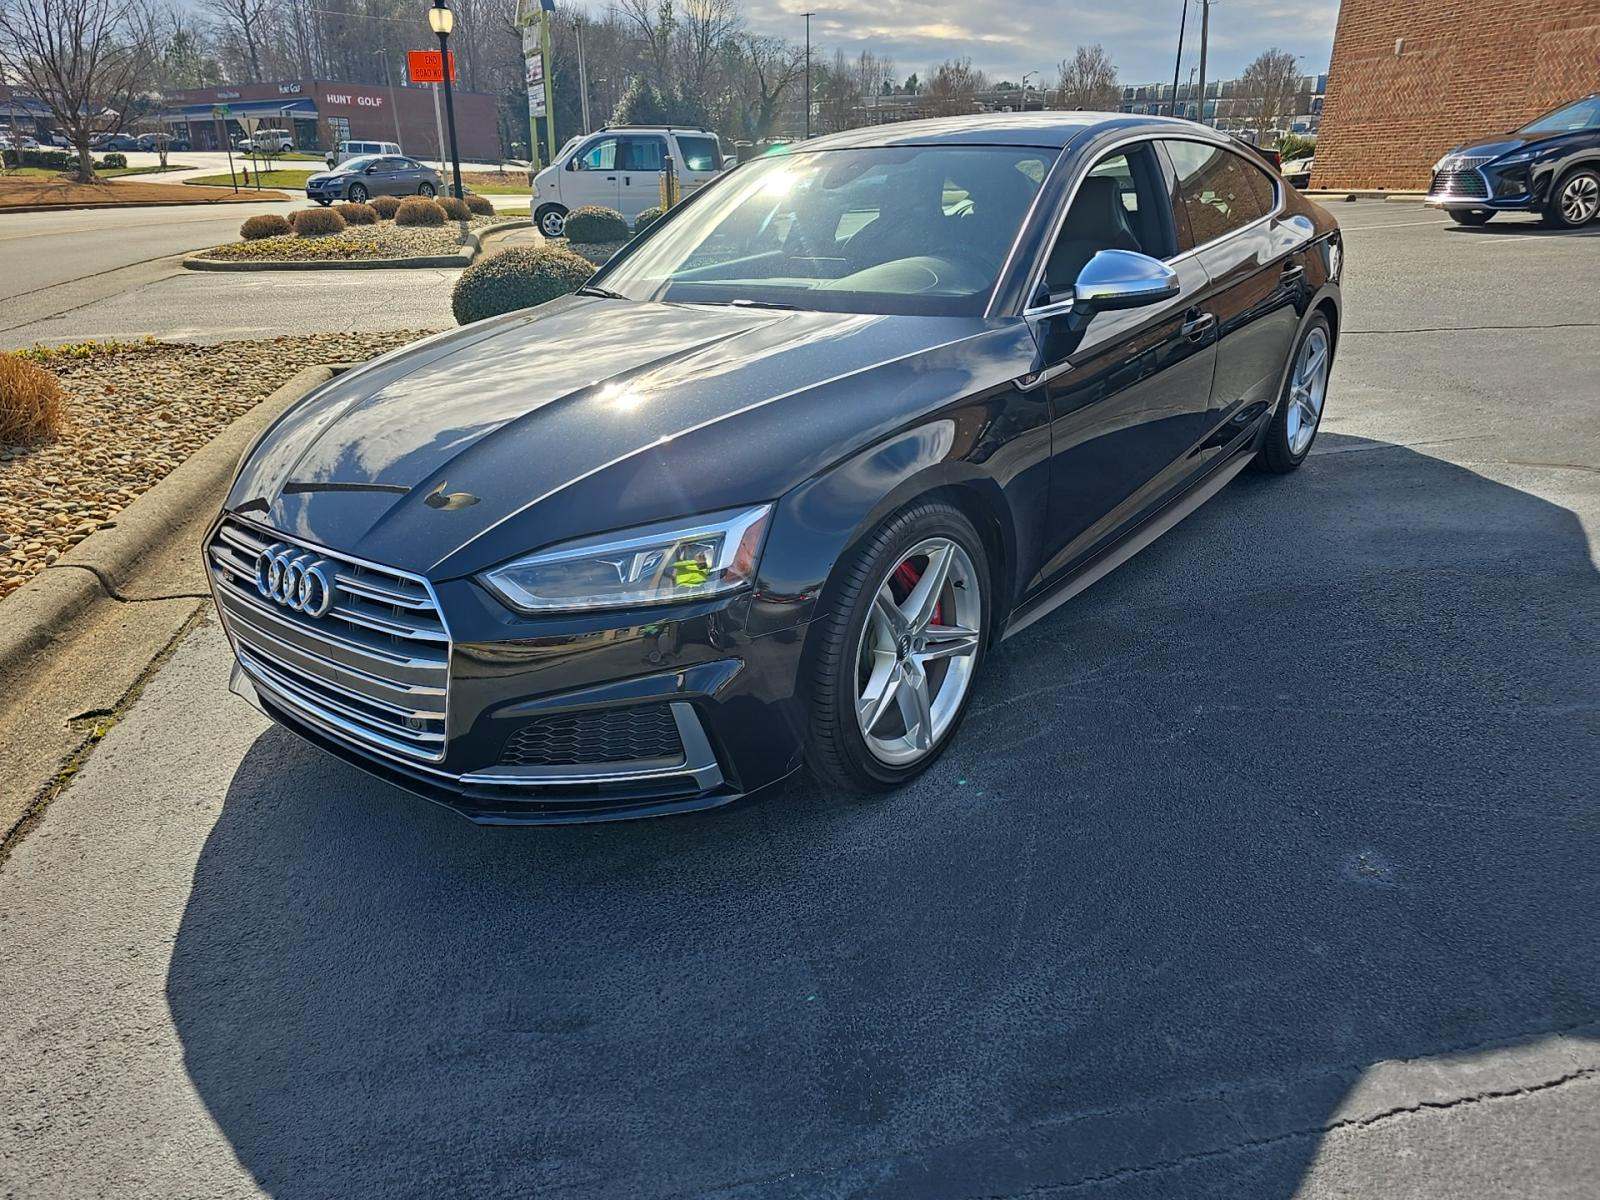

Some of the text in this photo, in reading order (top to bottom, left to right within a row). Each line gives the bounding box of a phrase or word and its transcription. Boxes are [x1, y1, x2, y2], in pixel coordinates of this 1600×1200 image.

[424, 55, 437, 65] END
[415, 68, 431, 78] ROAD
[326, 94, 382, 107] HUNT GOLF
